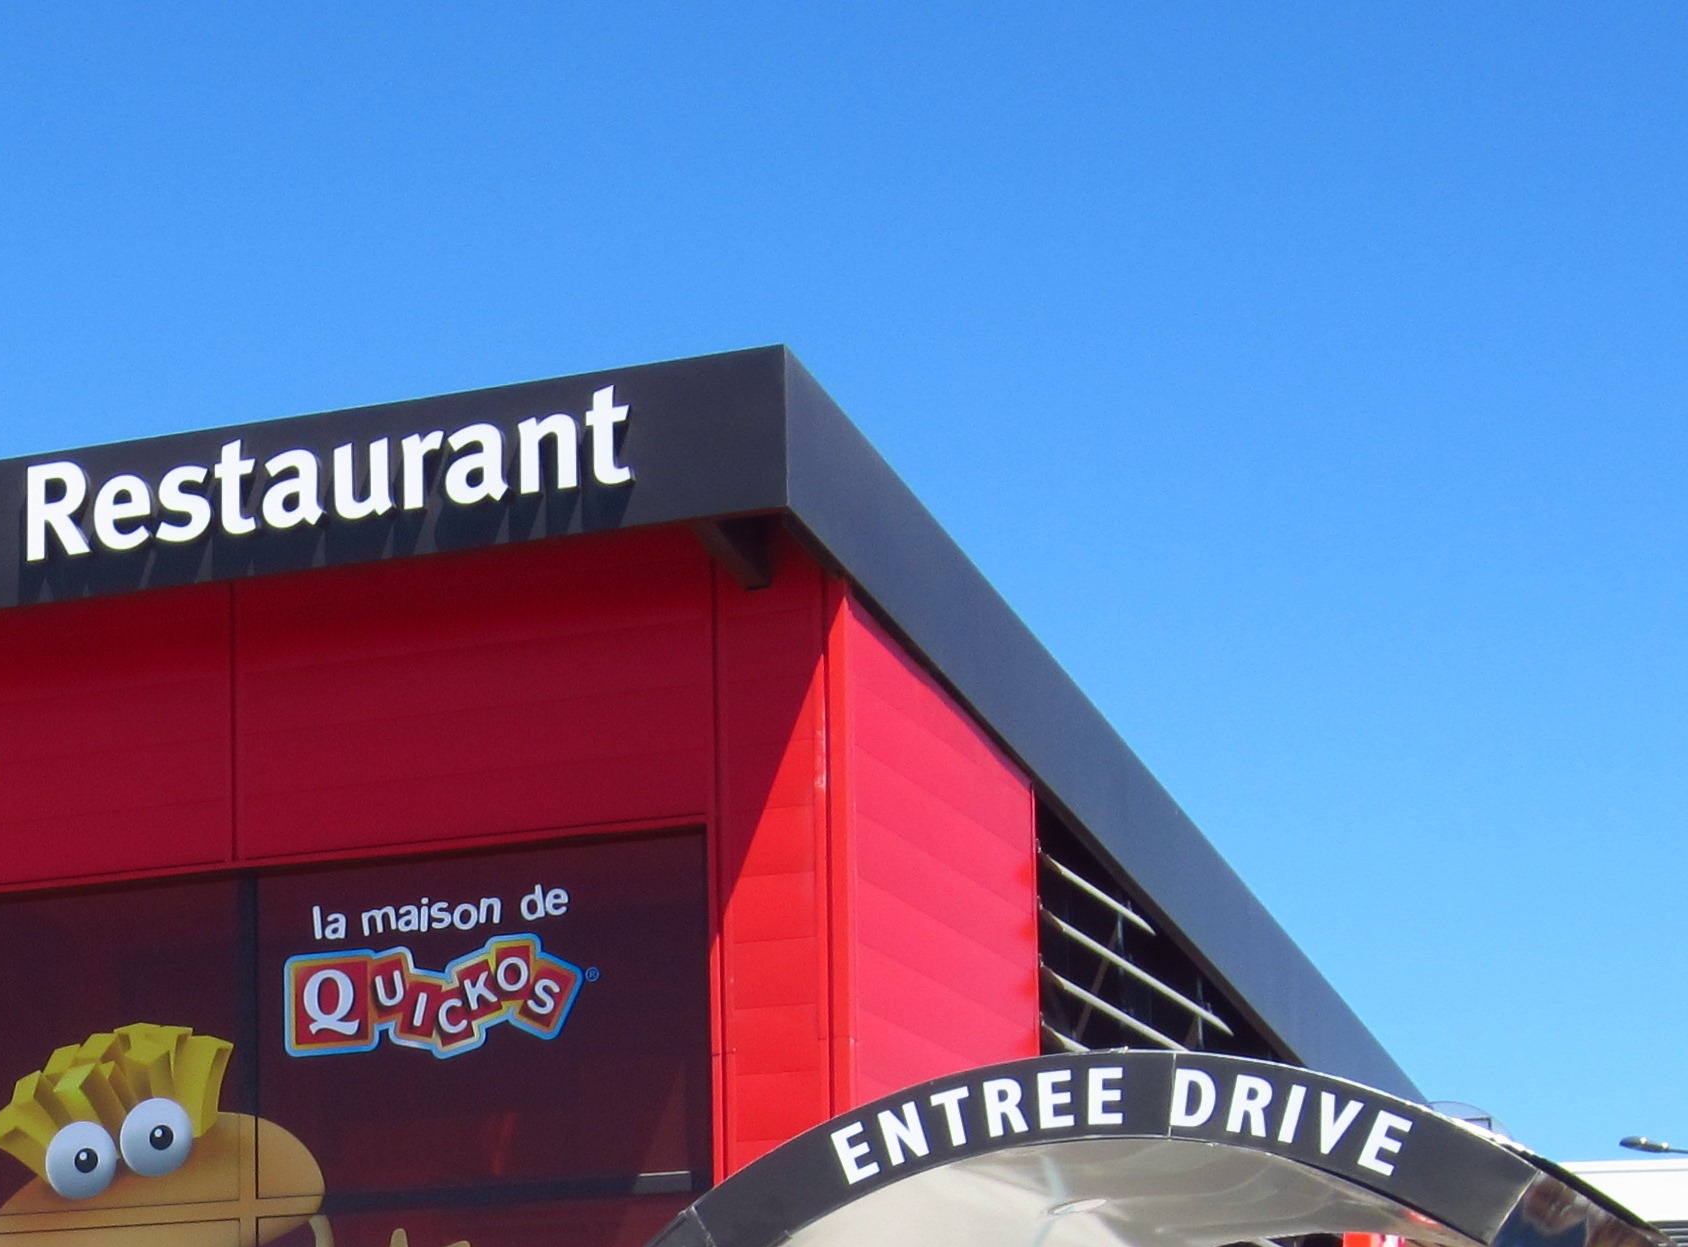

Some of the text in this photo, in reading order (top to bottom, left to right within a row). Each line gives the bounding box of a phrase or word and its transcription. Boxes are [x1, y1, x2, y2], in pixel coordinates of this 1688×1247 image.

[26, 384, 636, 562] Restaurant
[312, 884, 570, 940] la maison de
[302, 956, 561, 1036] QUICKOS
[830, 1066, 1413, 1186] ENTREE DRIVE
